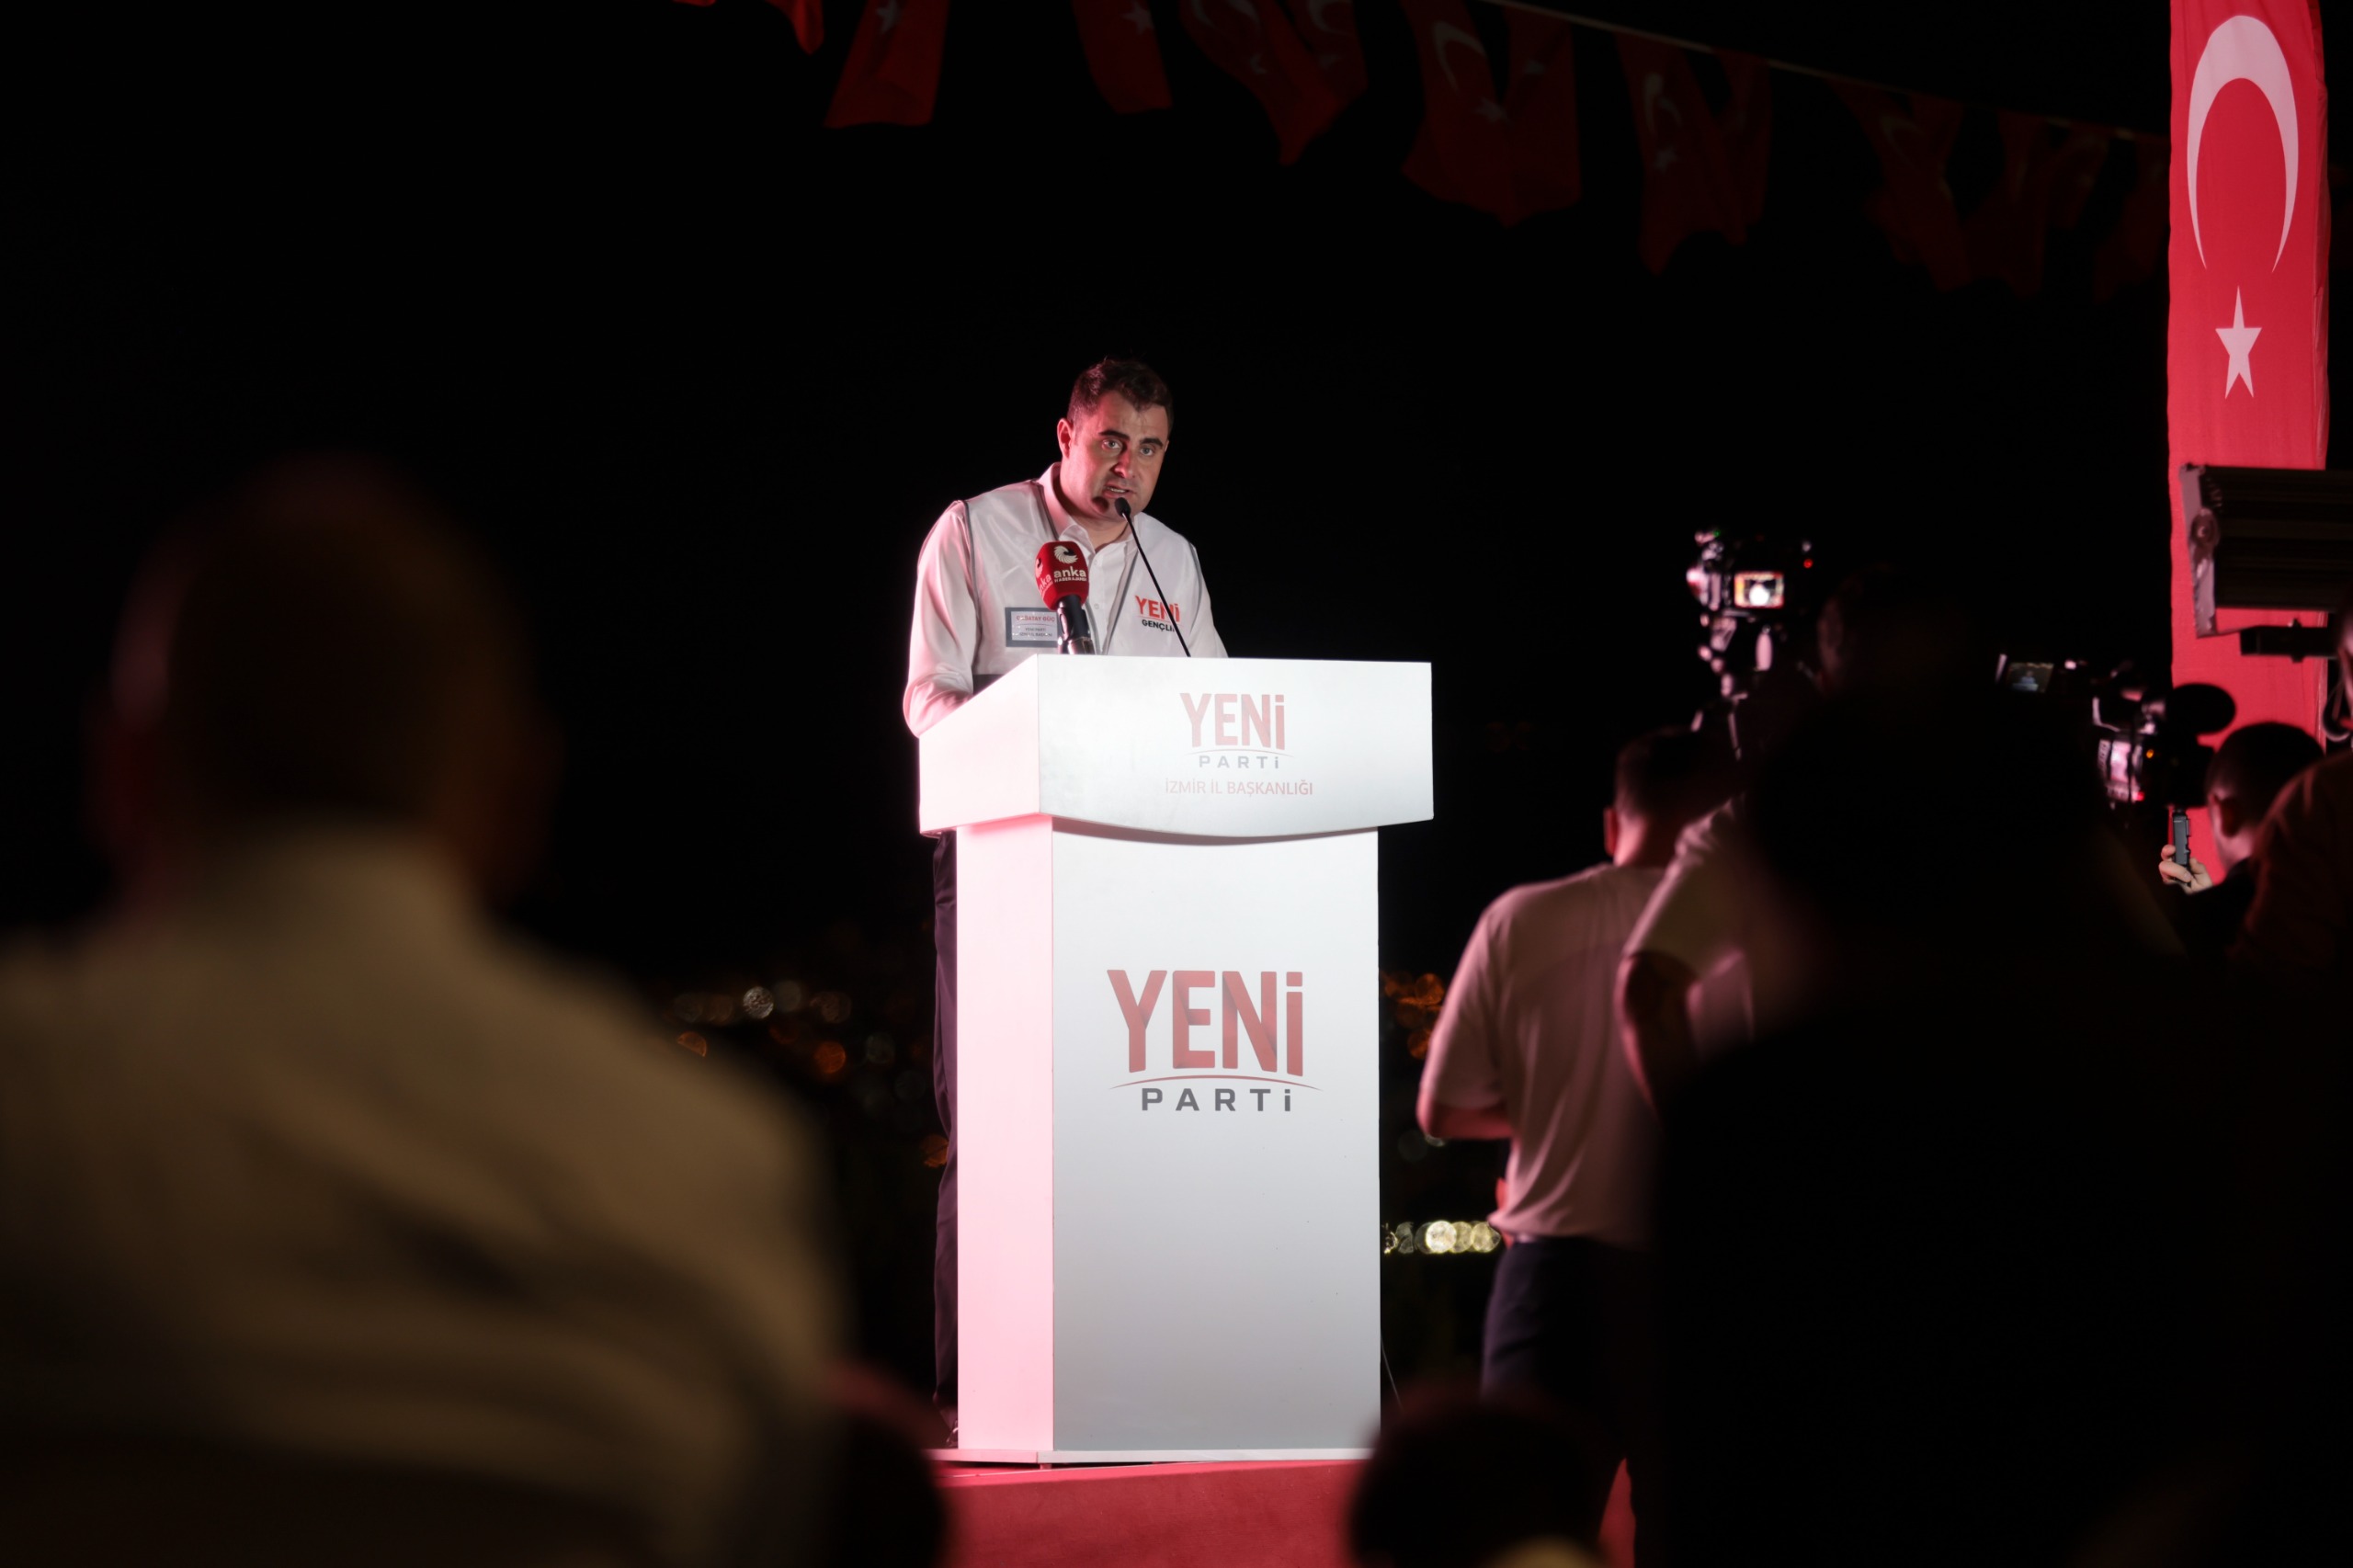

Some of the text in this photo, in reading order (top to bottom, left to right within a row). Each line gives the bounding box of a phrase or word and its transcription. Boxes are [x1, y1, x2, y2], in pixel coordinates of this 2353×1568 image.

[1053, 565, 1086, 578] anka
[1165, 778, 1313, 797] İZMİR İL BAŞKANLIĞI
